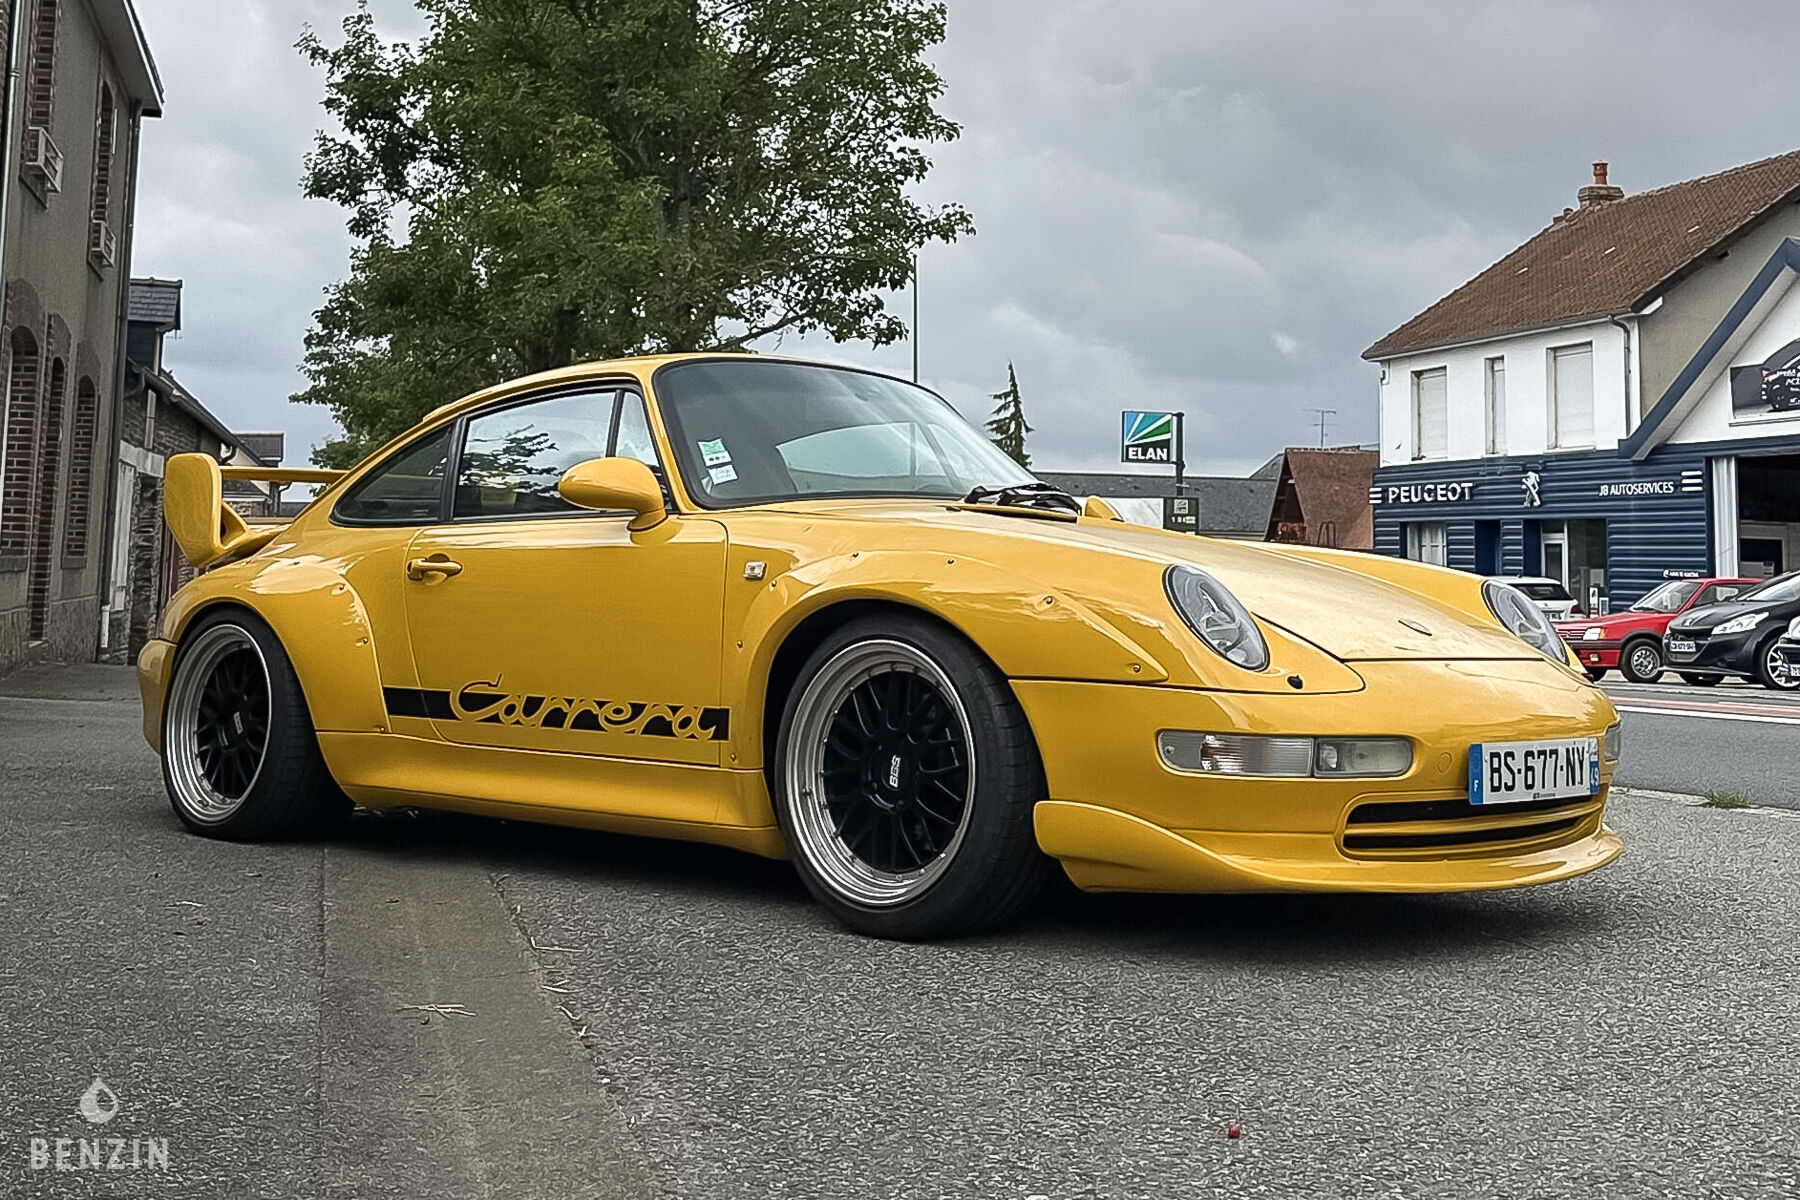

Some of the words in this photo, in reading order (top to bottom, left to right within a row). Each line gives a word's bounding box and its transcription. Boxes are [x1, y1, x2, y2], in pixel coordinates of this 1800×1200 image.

[1128, 447, 1168, 461] ELAN
[1388, 482, 1473, 504] PEUGEOT
[1599, 484, 1609, 496] JB
[1610, 481, 1675, 496] AUTOSERVICES
[449, 673, 717, 741] Carrera
[1489, 745, 1586, 793] BS-677-NY
